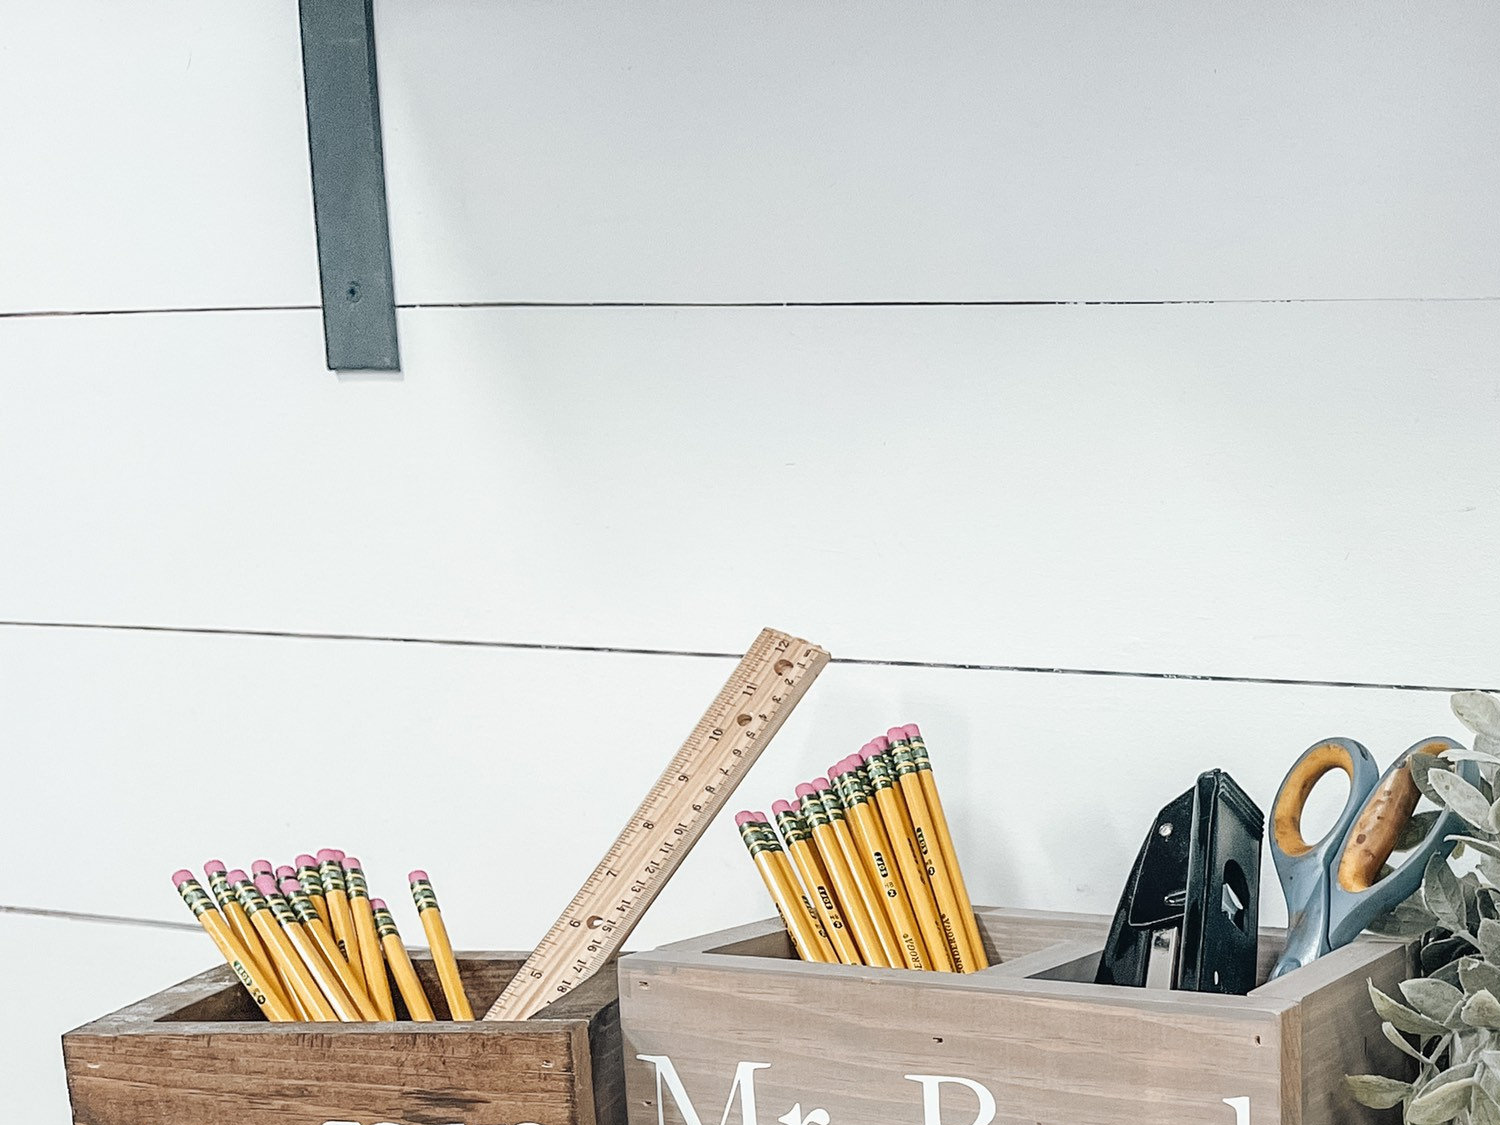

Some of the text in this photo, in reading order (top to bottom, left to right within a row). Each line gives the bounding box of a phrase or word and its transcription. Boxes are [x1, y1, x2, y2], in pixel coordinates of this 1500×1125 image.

[784, 678, 794, 686] 2
[771, 695, 782, 703] 3
[758, 713, 768, 721] 4
[746, 730, 756, 739] 5
[732, 748, 742, 757] 6
[719, 767, 729, 776] 7
[705, 785, 716, 794] 8
[530, 640, 790, 979] 5 6 7 8 9 10 11 12
[692, 804, 702, 812] 9
[674, 822, 688, 835] 10
[659, 842, 673, 854] 11
[645, 860, 660, 874] 12
[874, 851, 888, 878] SOFT
[631, 880, 646, 893] 13
[817, 886, 833, 910] SOFT
[616, 899, 631, 912] 14
[602, 919, 616, 933] 15
[587, 939, 602, 952] 16
[903, 935, 924, 970] EROGA
[572, 959, 587, 973] 17
[557, 979, 572, 993] 18
